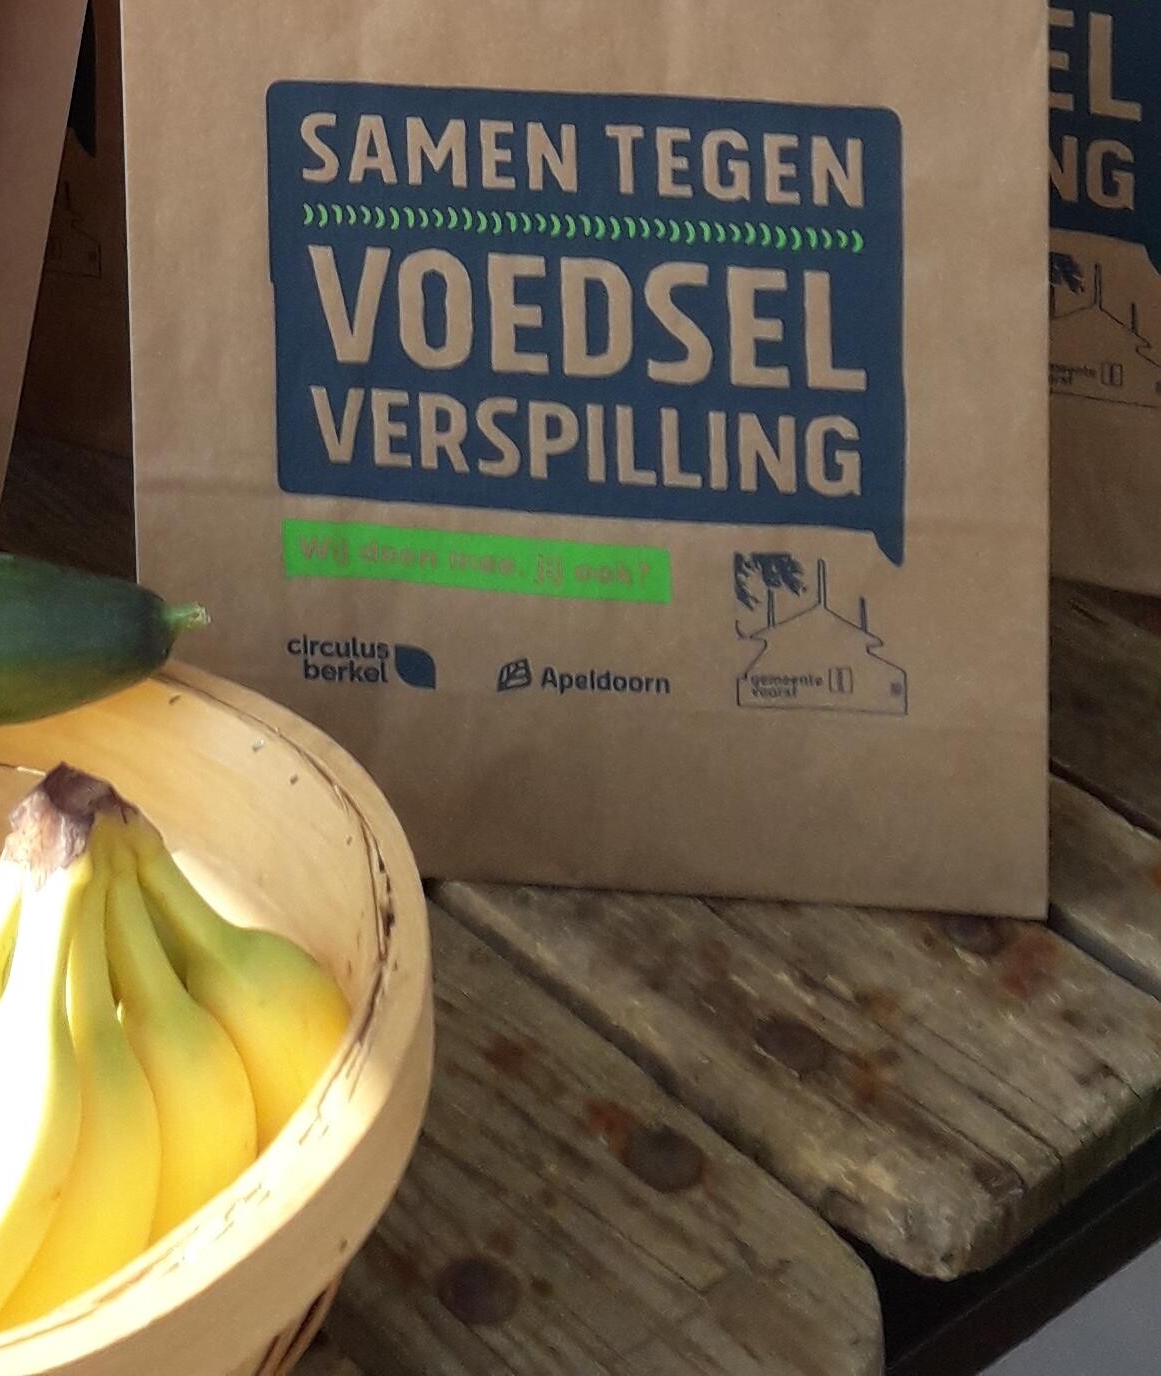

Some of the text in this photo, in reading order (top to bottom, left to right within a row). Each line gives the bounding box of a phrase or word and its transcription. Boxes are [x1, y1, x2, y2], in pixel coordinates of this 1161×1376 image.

[300, 112, 864, 208] SAMEN TEGEN
[308, 245, 866, 391] VOEDSEL
[310, 385, 862, 496] VERSPILLING
[287, 634, 390, 660] circulus
[303, 659, 388, 684] berkel
[541, 665, 671, 694] Apeldoorn
